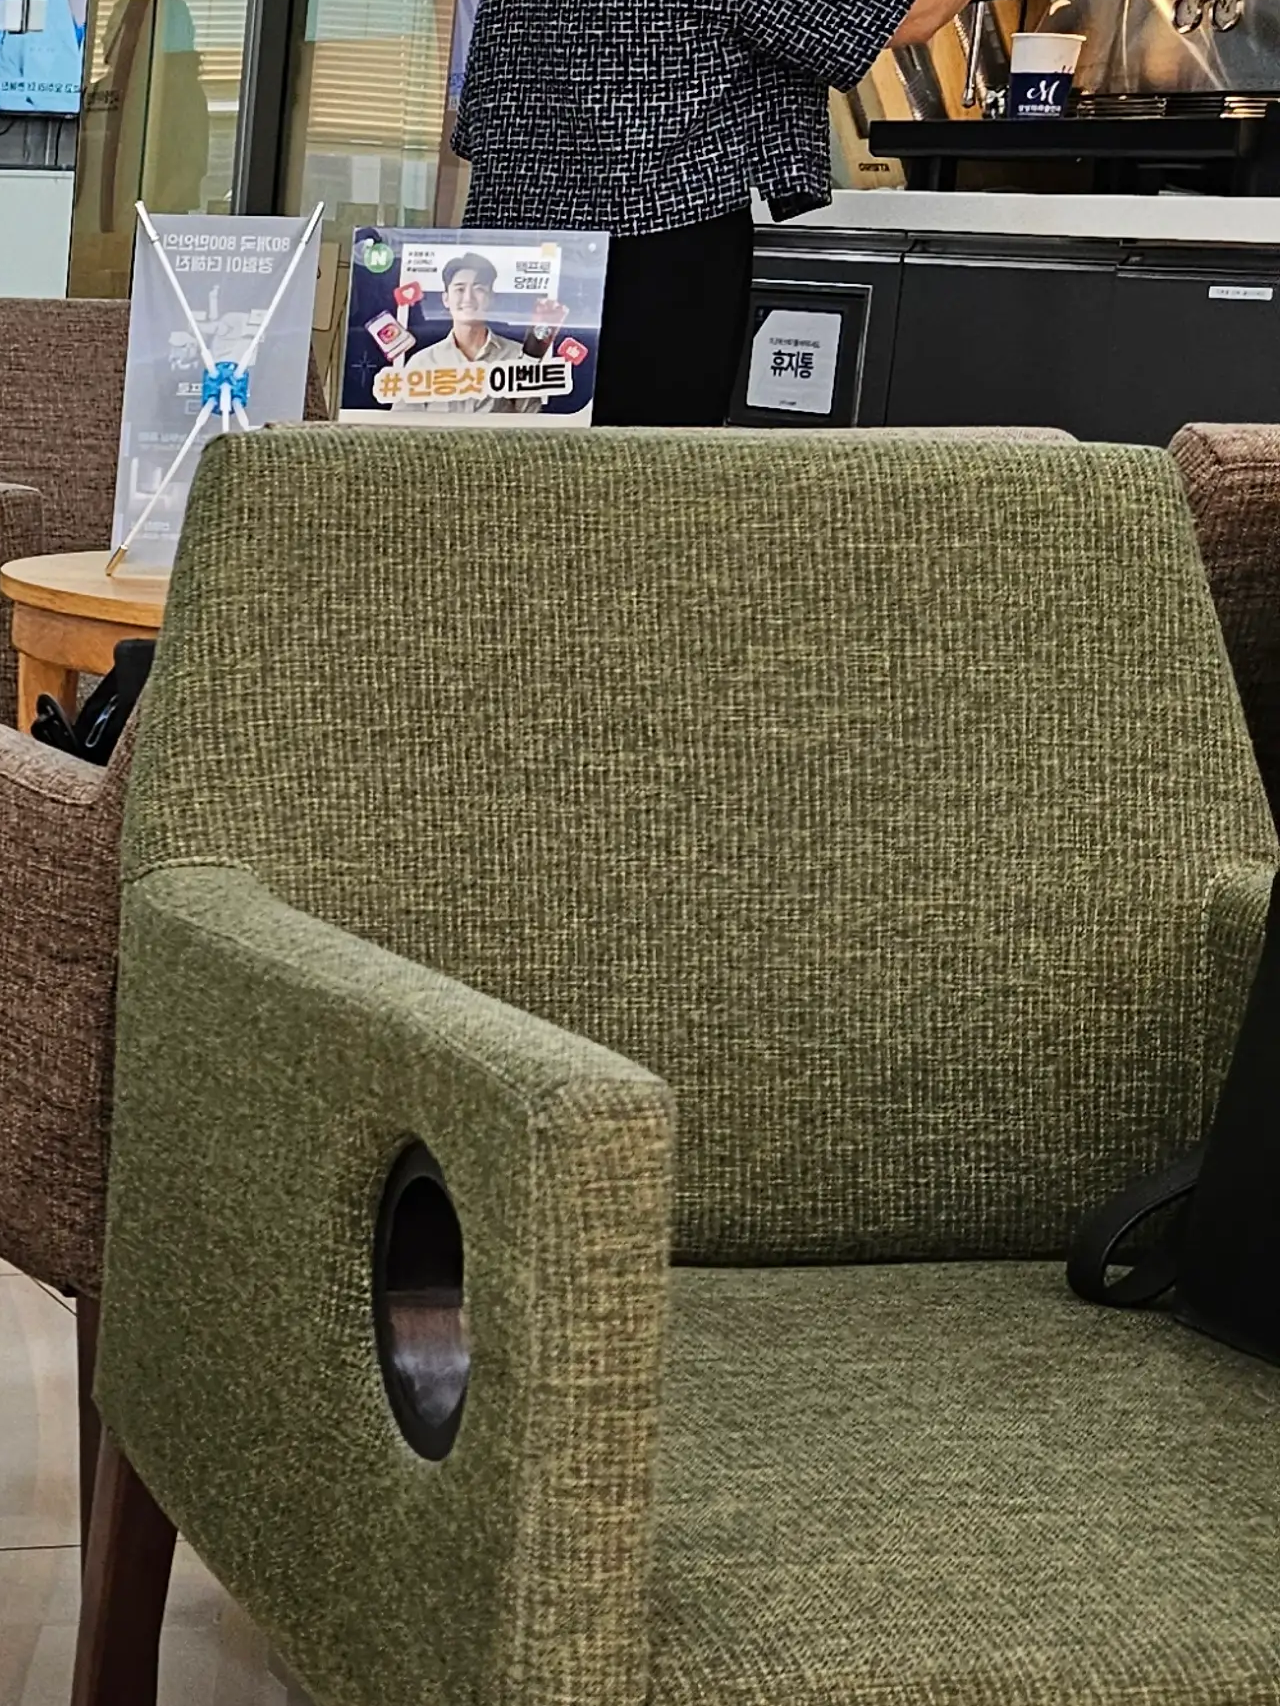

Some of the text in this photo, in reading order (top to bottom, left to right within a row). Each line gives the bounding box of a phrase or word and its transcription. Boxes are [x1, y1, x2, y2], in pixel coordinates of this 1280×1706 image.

[369, 250, 388, 266] N
[513, 276, 550, 290] 당첨!!
[770, 349, 815, 379] 휴지통
[490, 364, 566, 392] 이벤트
